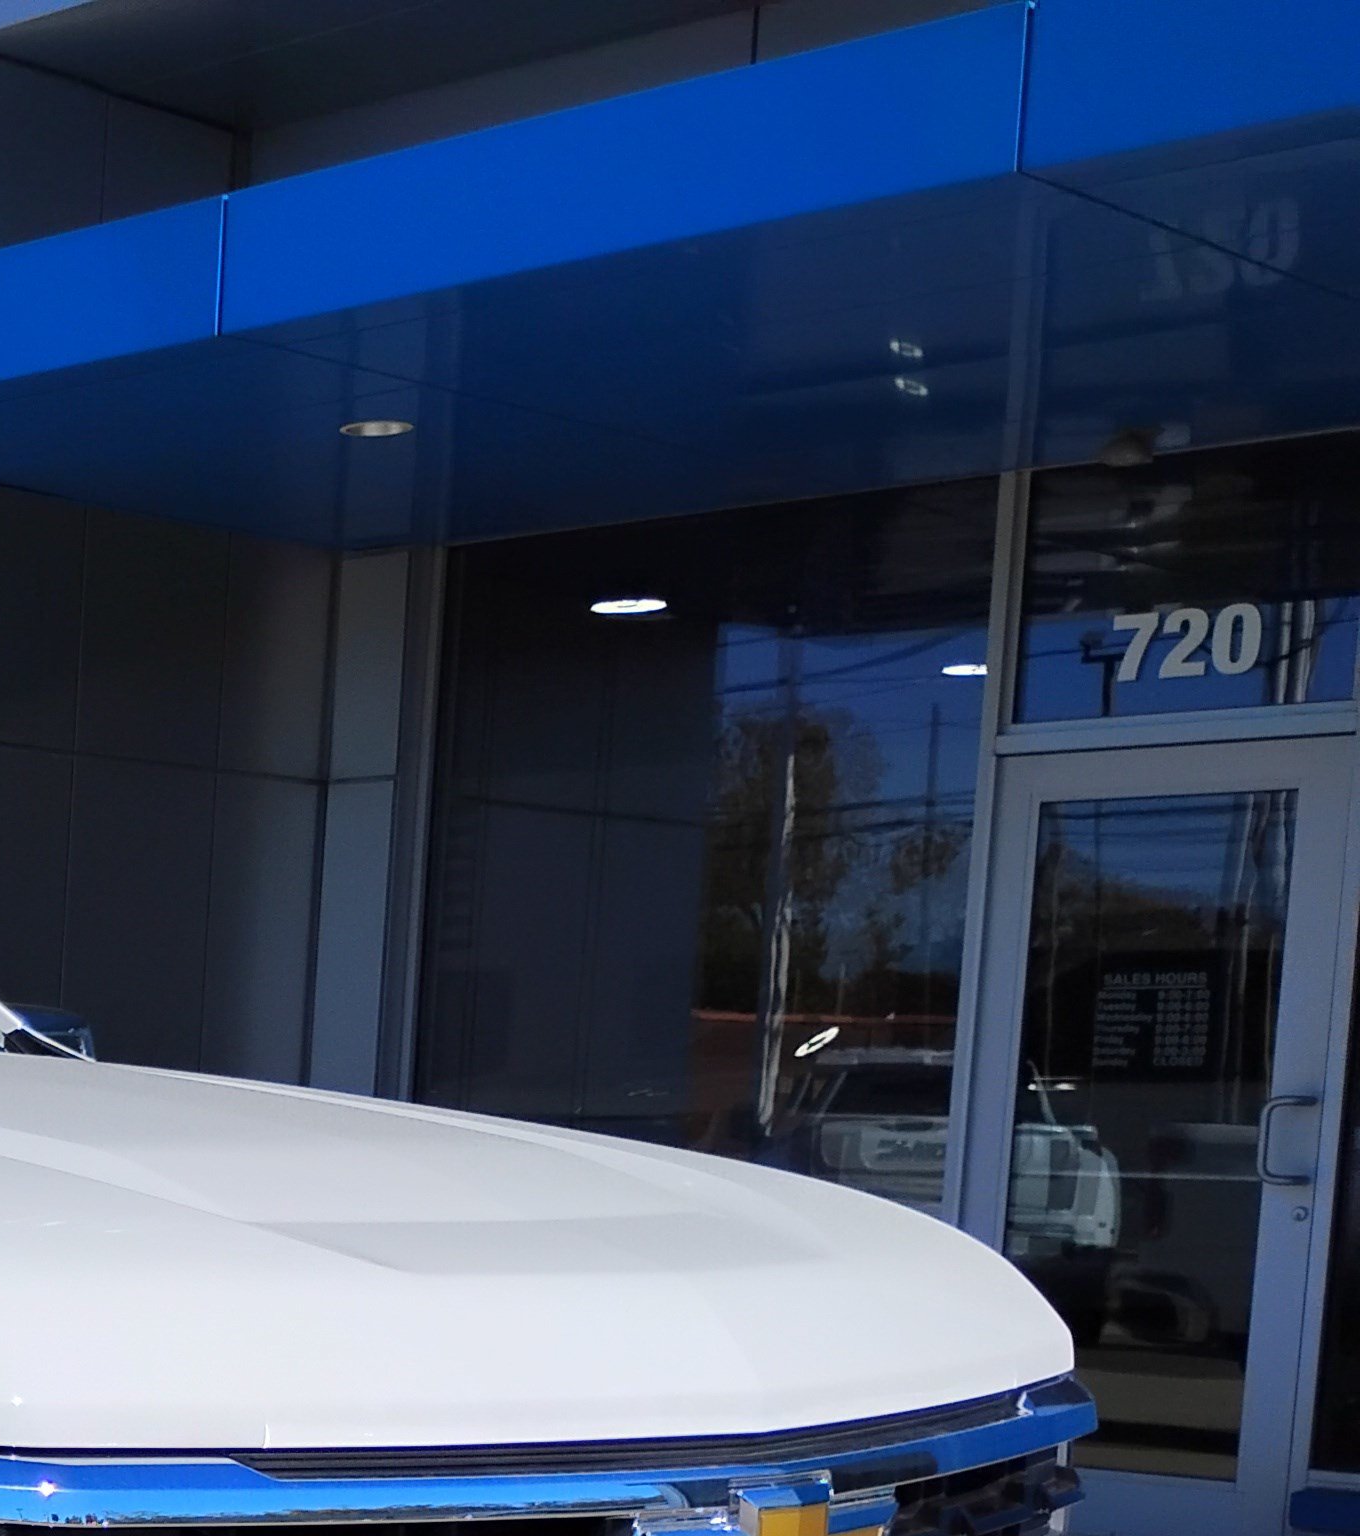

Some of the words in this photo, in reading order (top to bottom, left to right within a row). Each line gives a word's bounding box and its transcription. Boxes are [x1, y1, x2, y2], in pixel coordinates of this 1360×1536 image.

[1112, 602, 1262, 683] 720
[1103, 972, 1151, 986] SALES
[1155, 971, 1208, 985] HOURS
